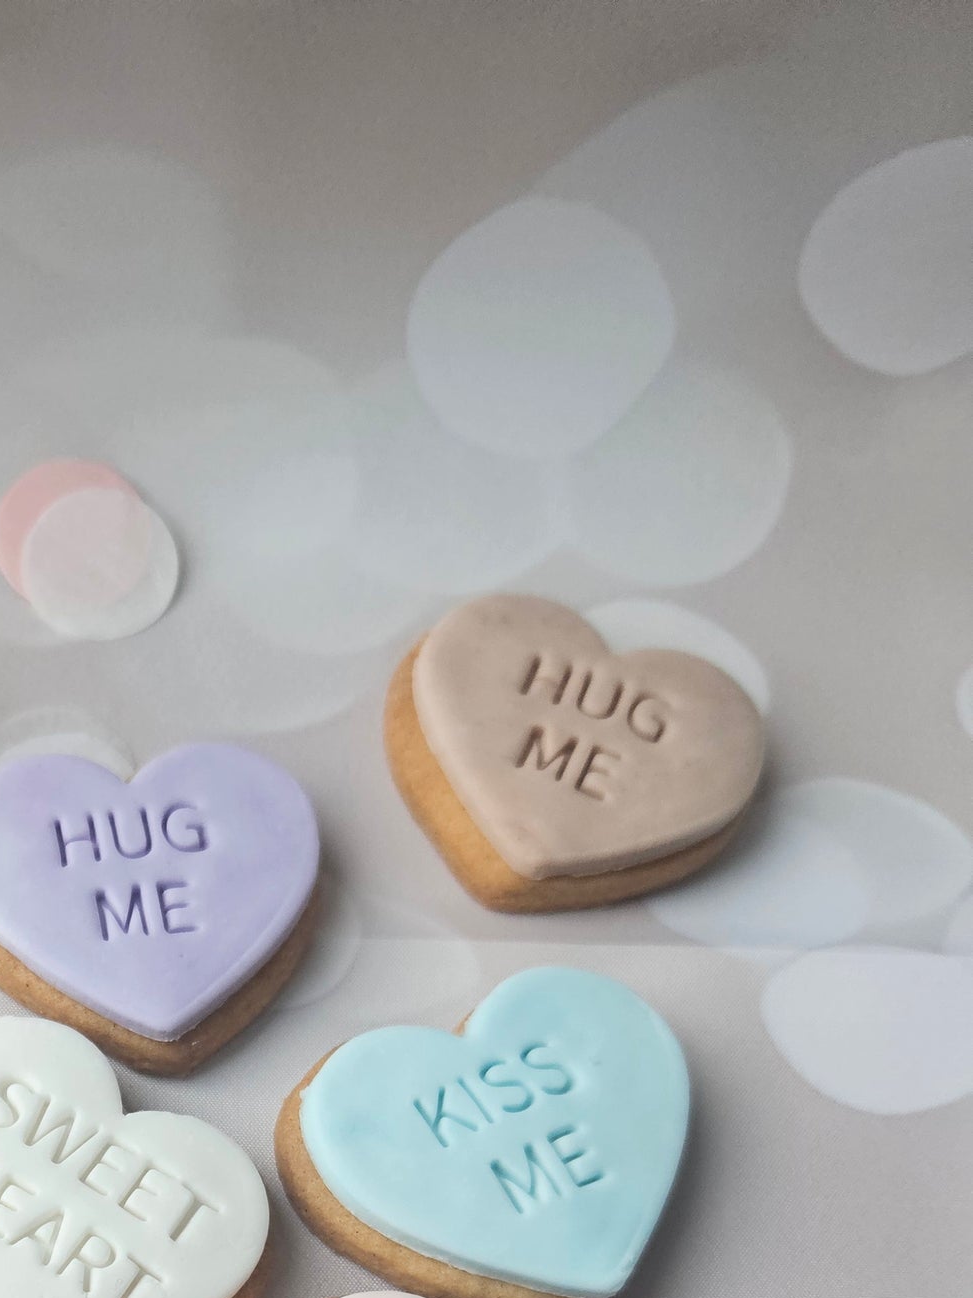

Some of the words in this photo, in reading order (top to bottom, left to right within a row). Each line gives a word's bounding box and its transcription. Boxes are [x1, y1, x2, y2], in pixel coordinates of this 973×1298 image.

[518, 655, 670, 743] HUG
[515, 725, 621, 801] ME
[53, 801, 208, 868] HUG
[95, 881, 197, 941] ME
[413, 1041, 573, 1148] KISS
[490, 1124, 604, 1214] ME
